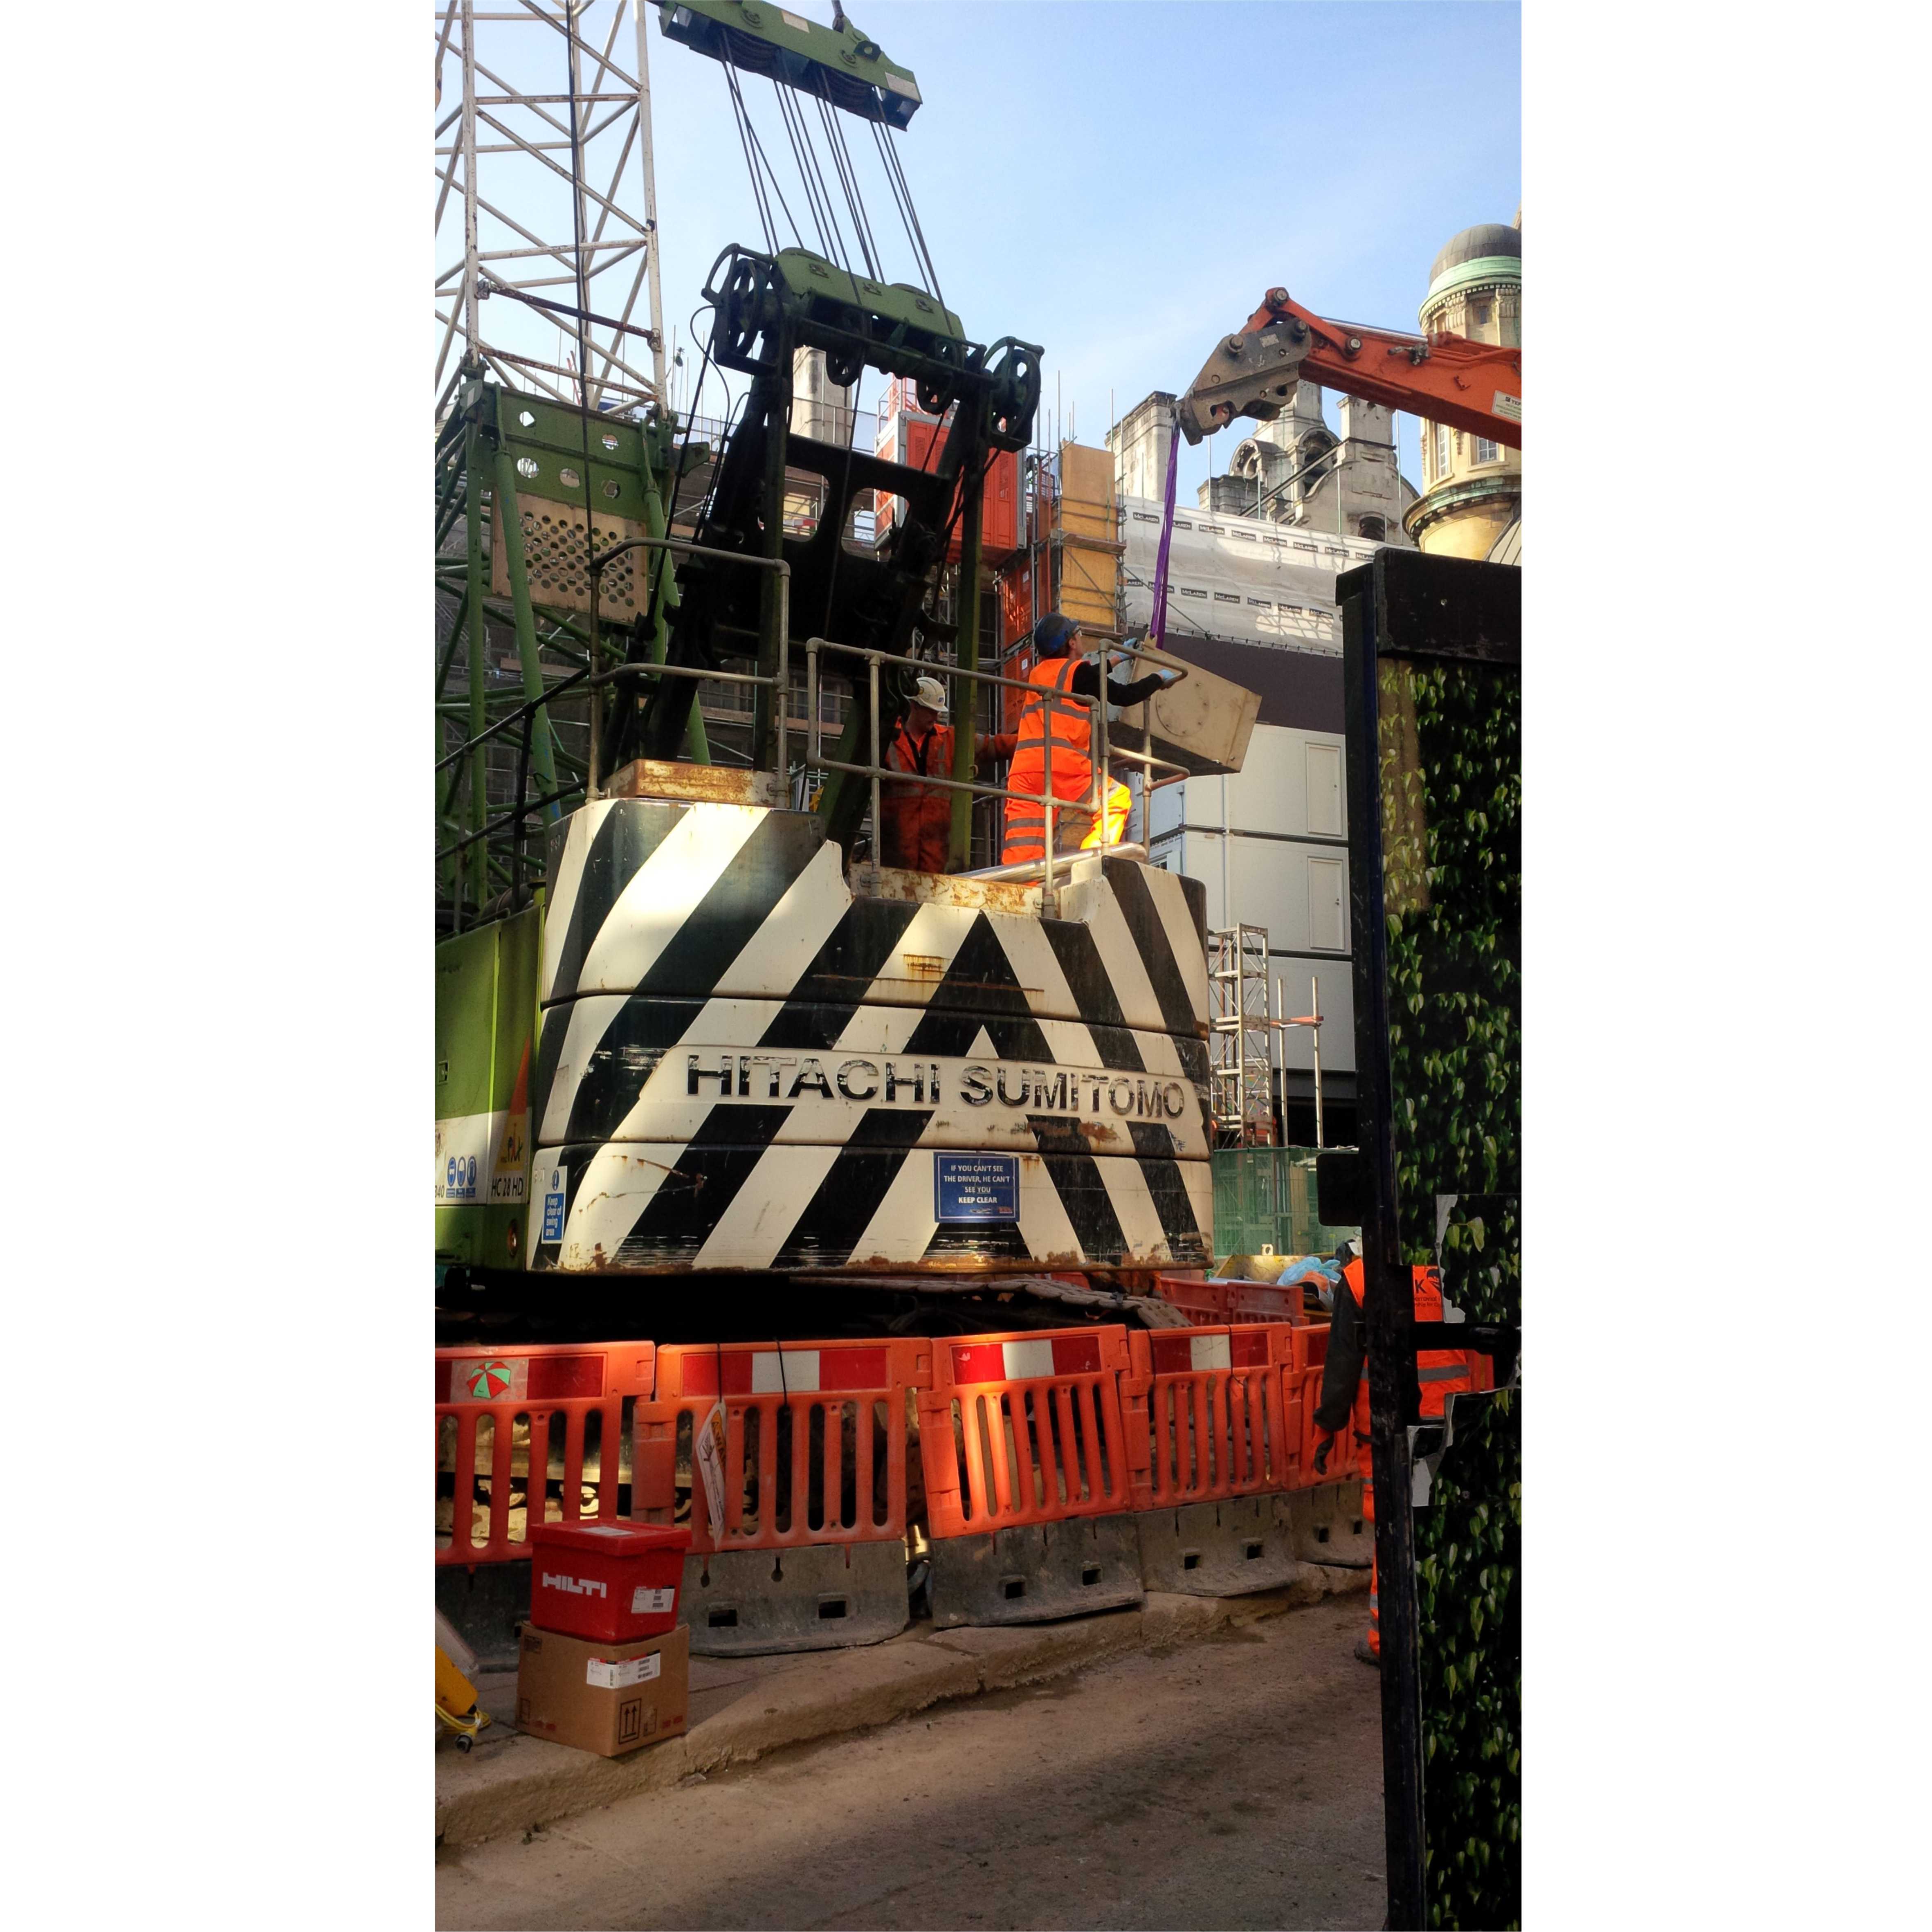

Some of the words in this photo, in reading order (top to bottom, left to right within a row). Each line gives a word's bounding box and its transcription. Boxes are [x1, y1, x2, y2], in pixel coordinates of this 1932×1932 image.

[687, 1054, 941, 1103] HITACHI
[960, 1065, 1185, 1119] SUMITOMO
[492, 1178, 501, 1197] HC
[512, 1177, 523, 1197] HD
[547, 1196, 558, 1206] Keep
[542, 1572, 607, 1598] HILTI
